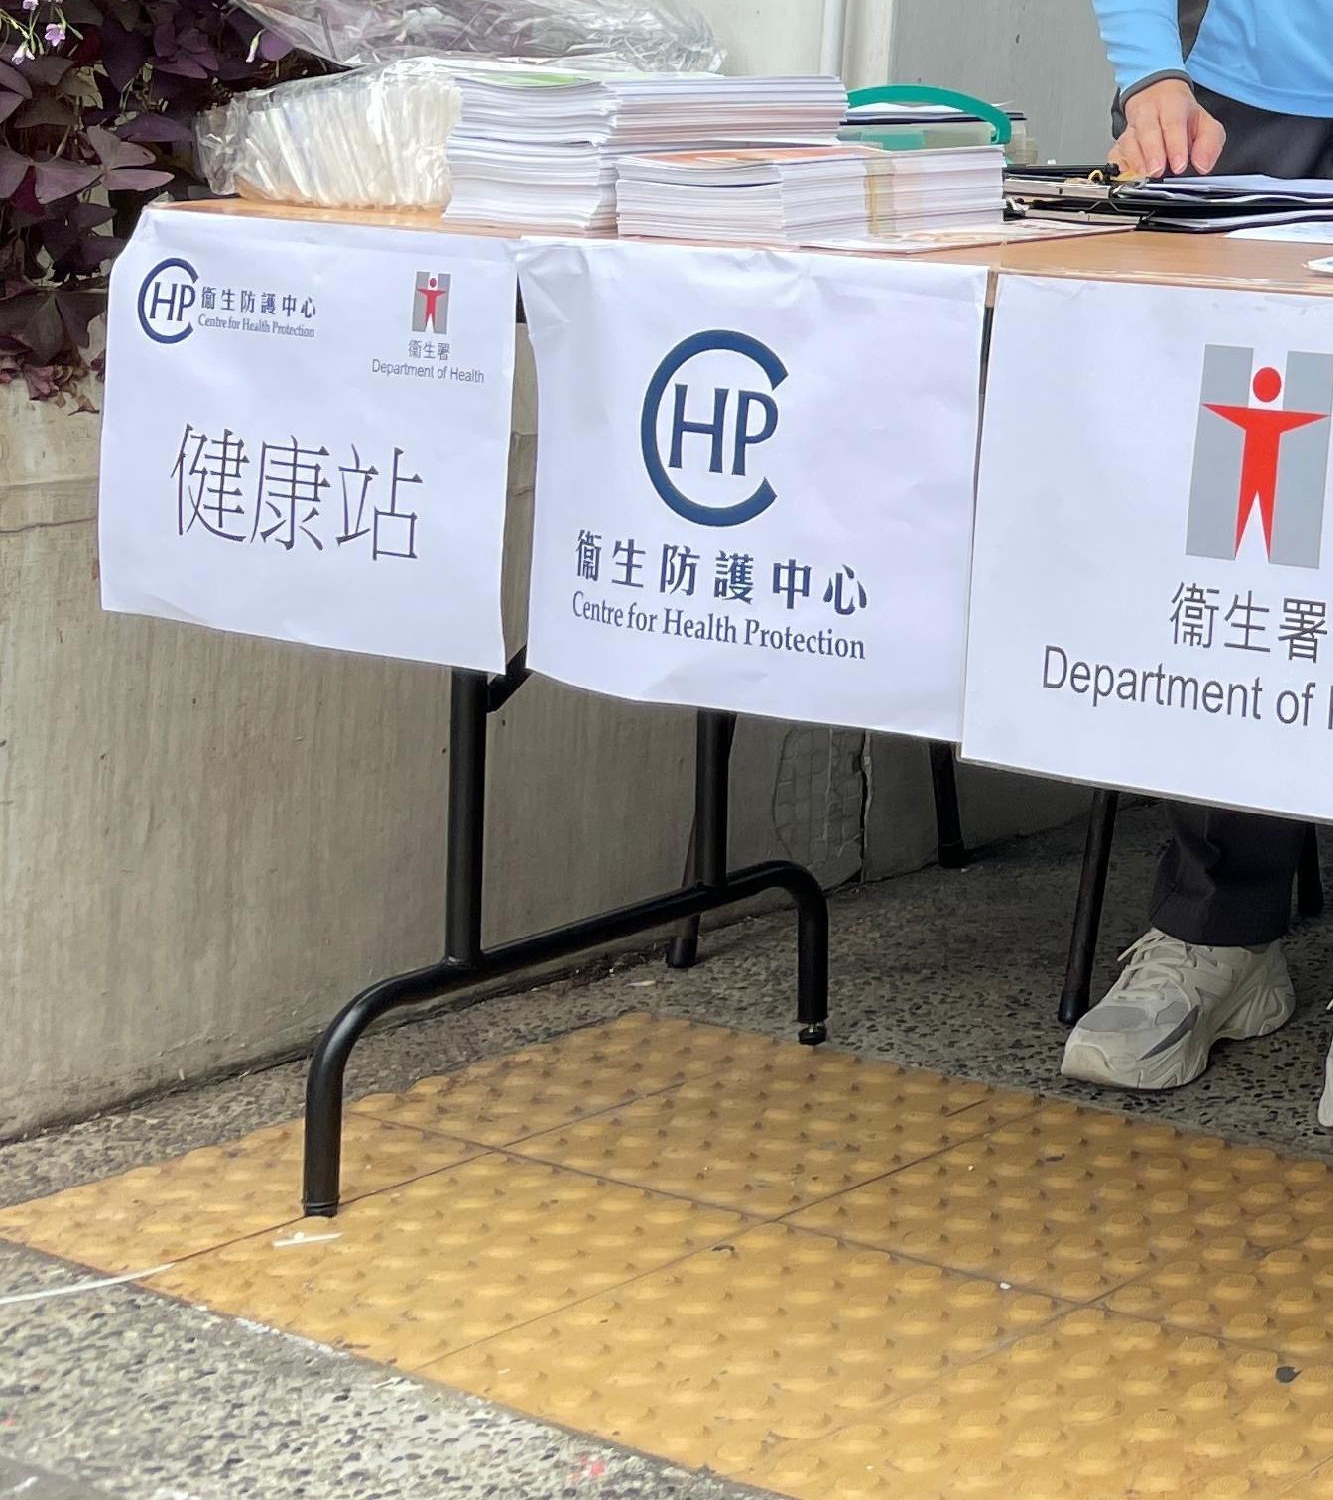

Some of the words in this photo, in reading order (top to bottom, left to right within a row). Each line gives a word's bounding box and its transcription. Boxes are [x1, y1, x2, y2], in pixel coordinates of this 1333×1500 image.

[138, 257, 200, 344] CHP
[197, 313, 228, 329] Centre
[228, 315, 242, 332] for
[242, 317, 271, 335] Health
[272, 321, 315, 338] Protection
[372, 359, 435, 380] Department
[437, 365, 447, 381] of
[450, 367, 485, 383] Health
[640, 328, 789, 527] CHP
[170, 422, 424, 562] 健康站
[572, 589, 624, 628] Centre
[627, 603, 658, 633] for
[663, 606, 737, 644] Health
[744, 618, 866, 660] Protection
[1042, 643, 1263, 720] Department
[1275, 681, 1317, 727] of
